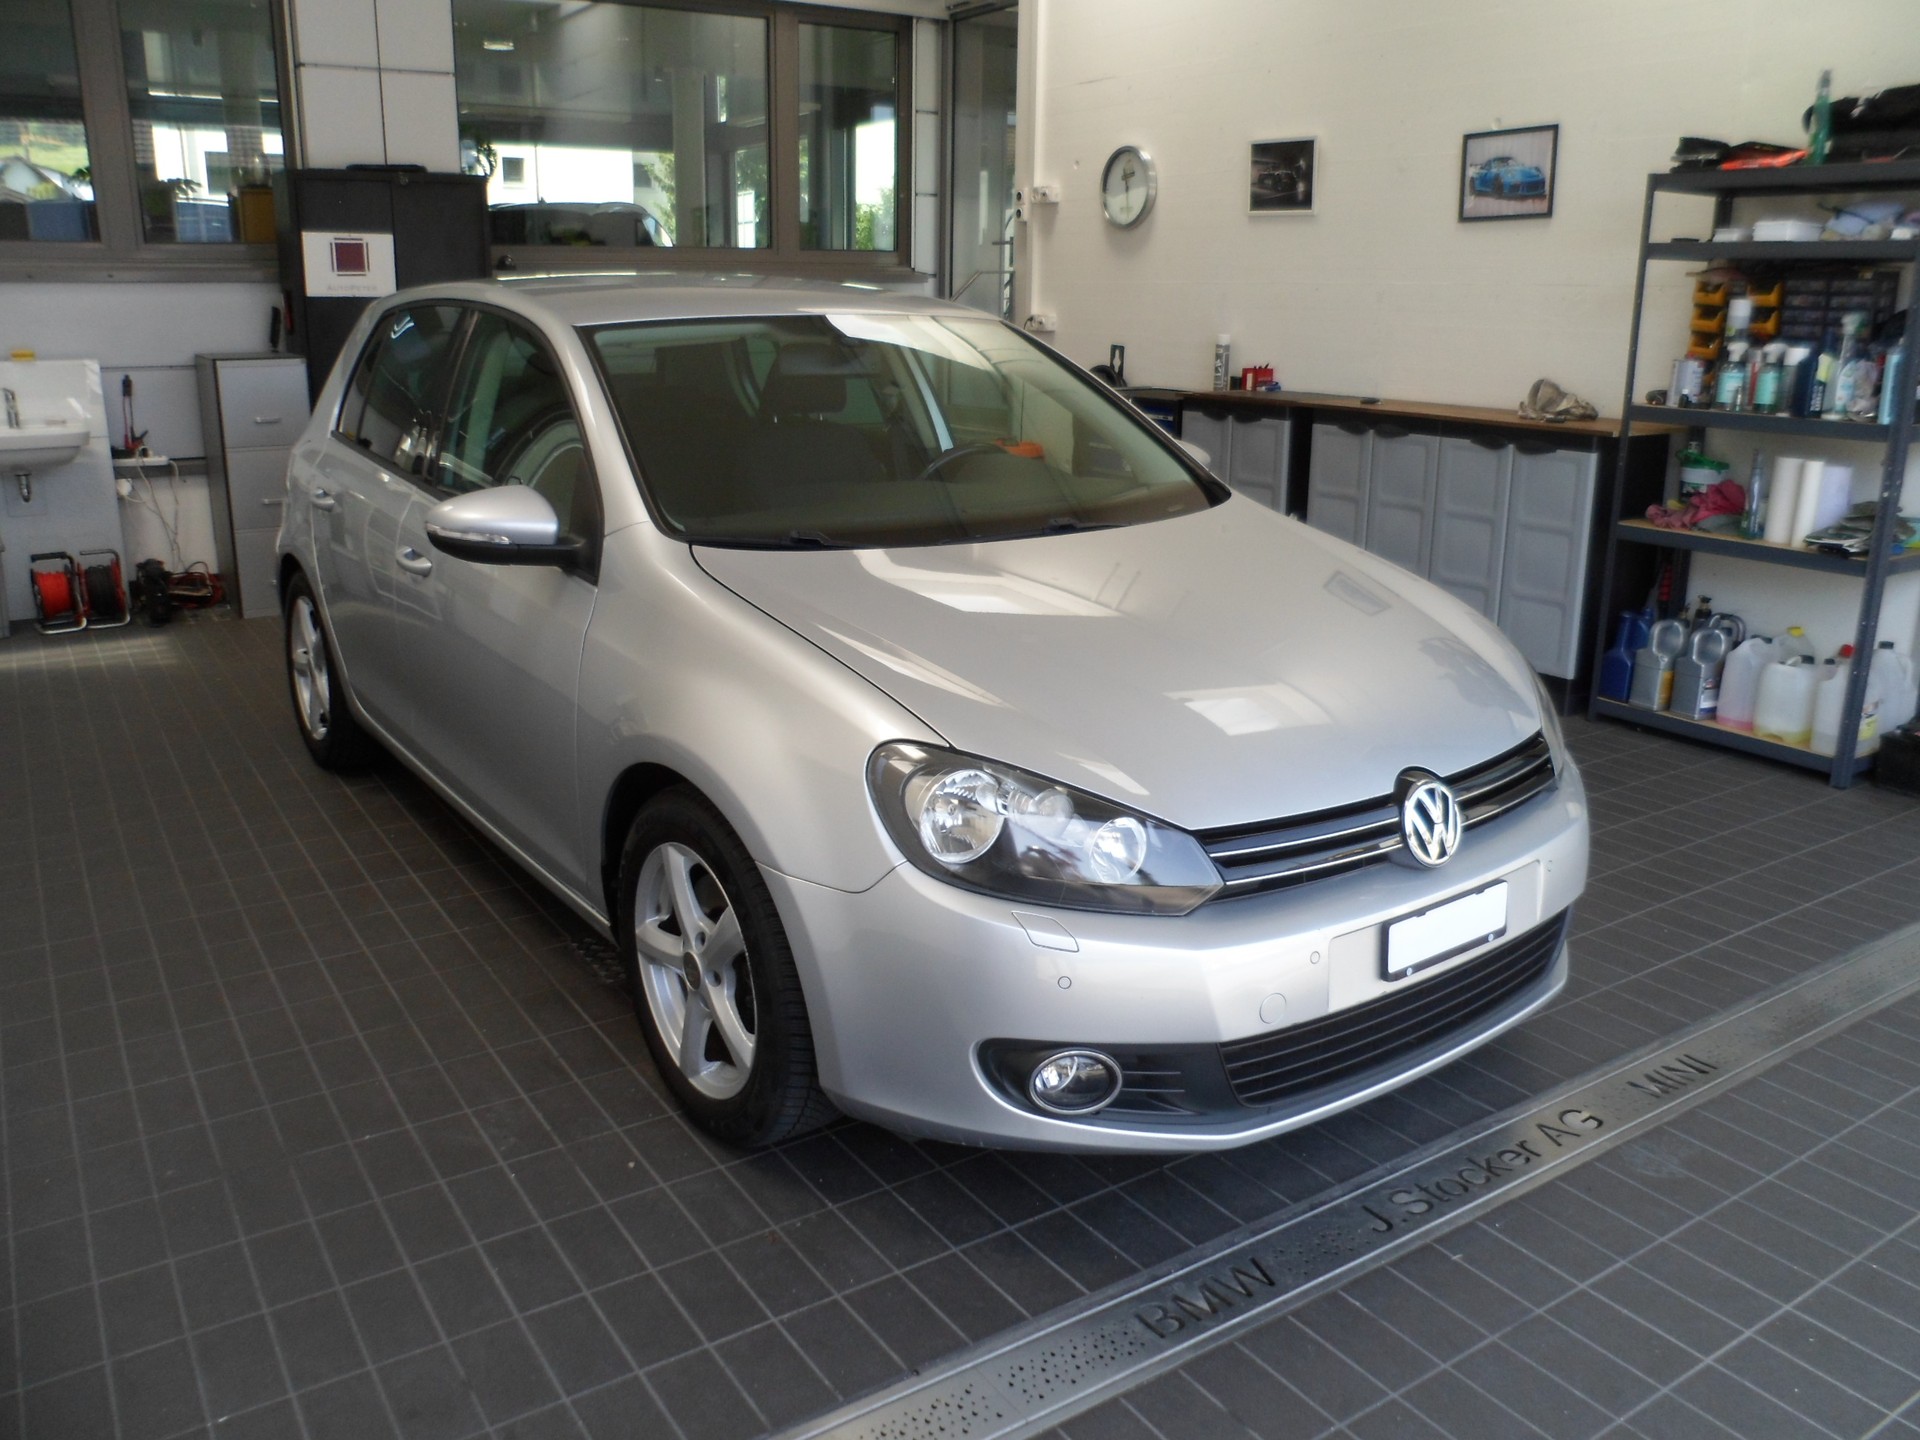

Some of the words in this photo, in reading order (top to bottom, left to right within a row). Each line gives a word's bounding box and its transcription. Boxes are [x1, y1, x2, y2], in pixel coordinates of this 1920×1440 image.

[1134, 1256, 1276, 1339] BMW
[1535, 1108, 1604, 1147] AG
[1625, 1053, 1719, 1099] MINI
